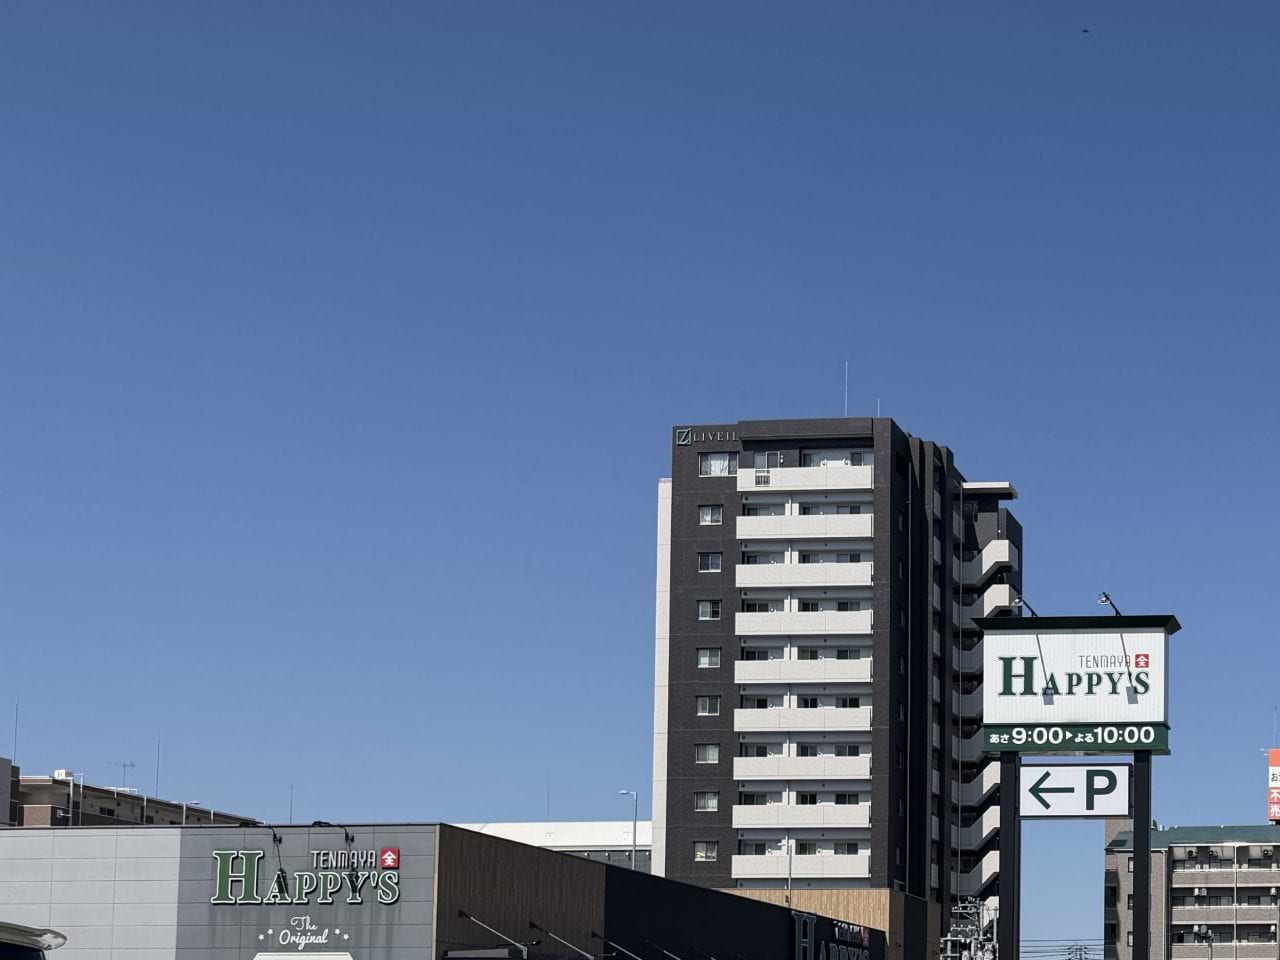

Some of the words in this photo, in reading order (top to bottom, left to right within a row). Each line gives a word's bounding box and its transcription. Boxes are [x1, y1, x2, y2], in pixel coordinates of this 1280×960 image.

[1079, 655, 1131, 669] TENMAYA
[998, 656, 1150, 696] HAPPY'S
[1085, 769, 1118, 811] P
[310, 850, 376, 869] TENMAYA
[211, 850, 400, 904] HAPPY'S
[290, 915, 318, 931] The
[278, 928, 329, 950] Original
